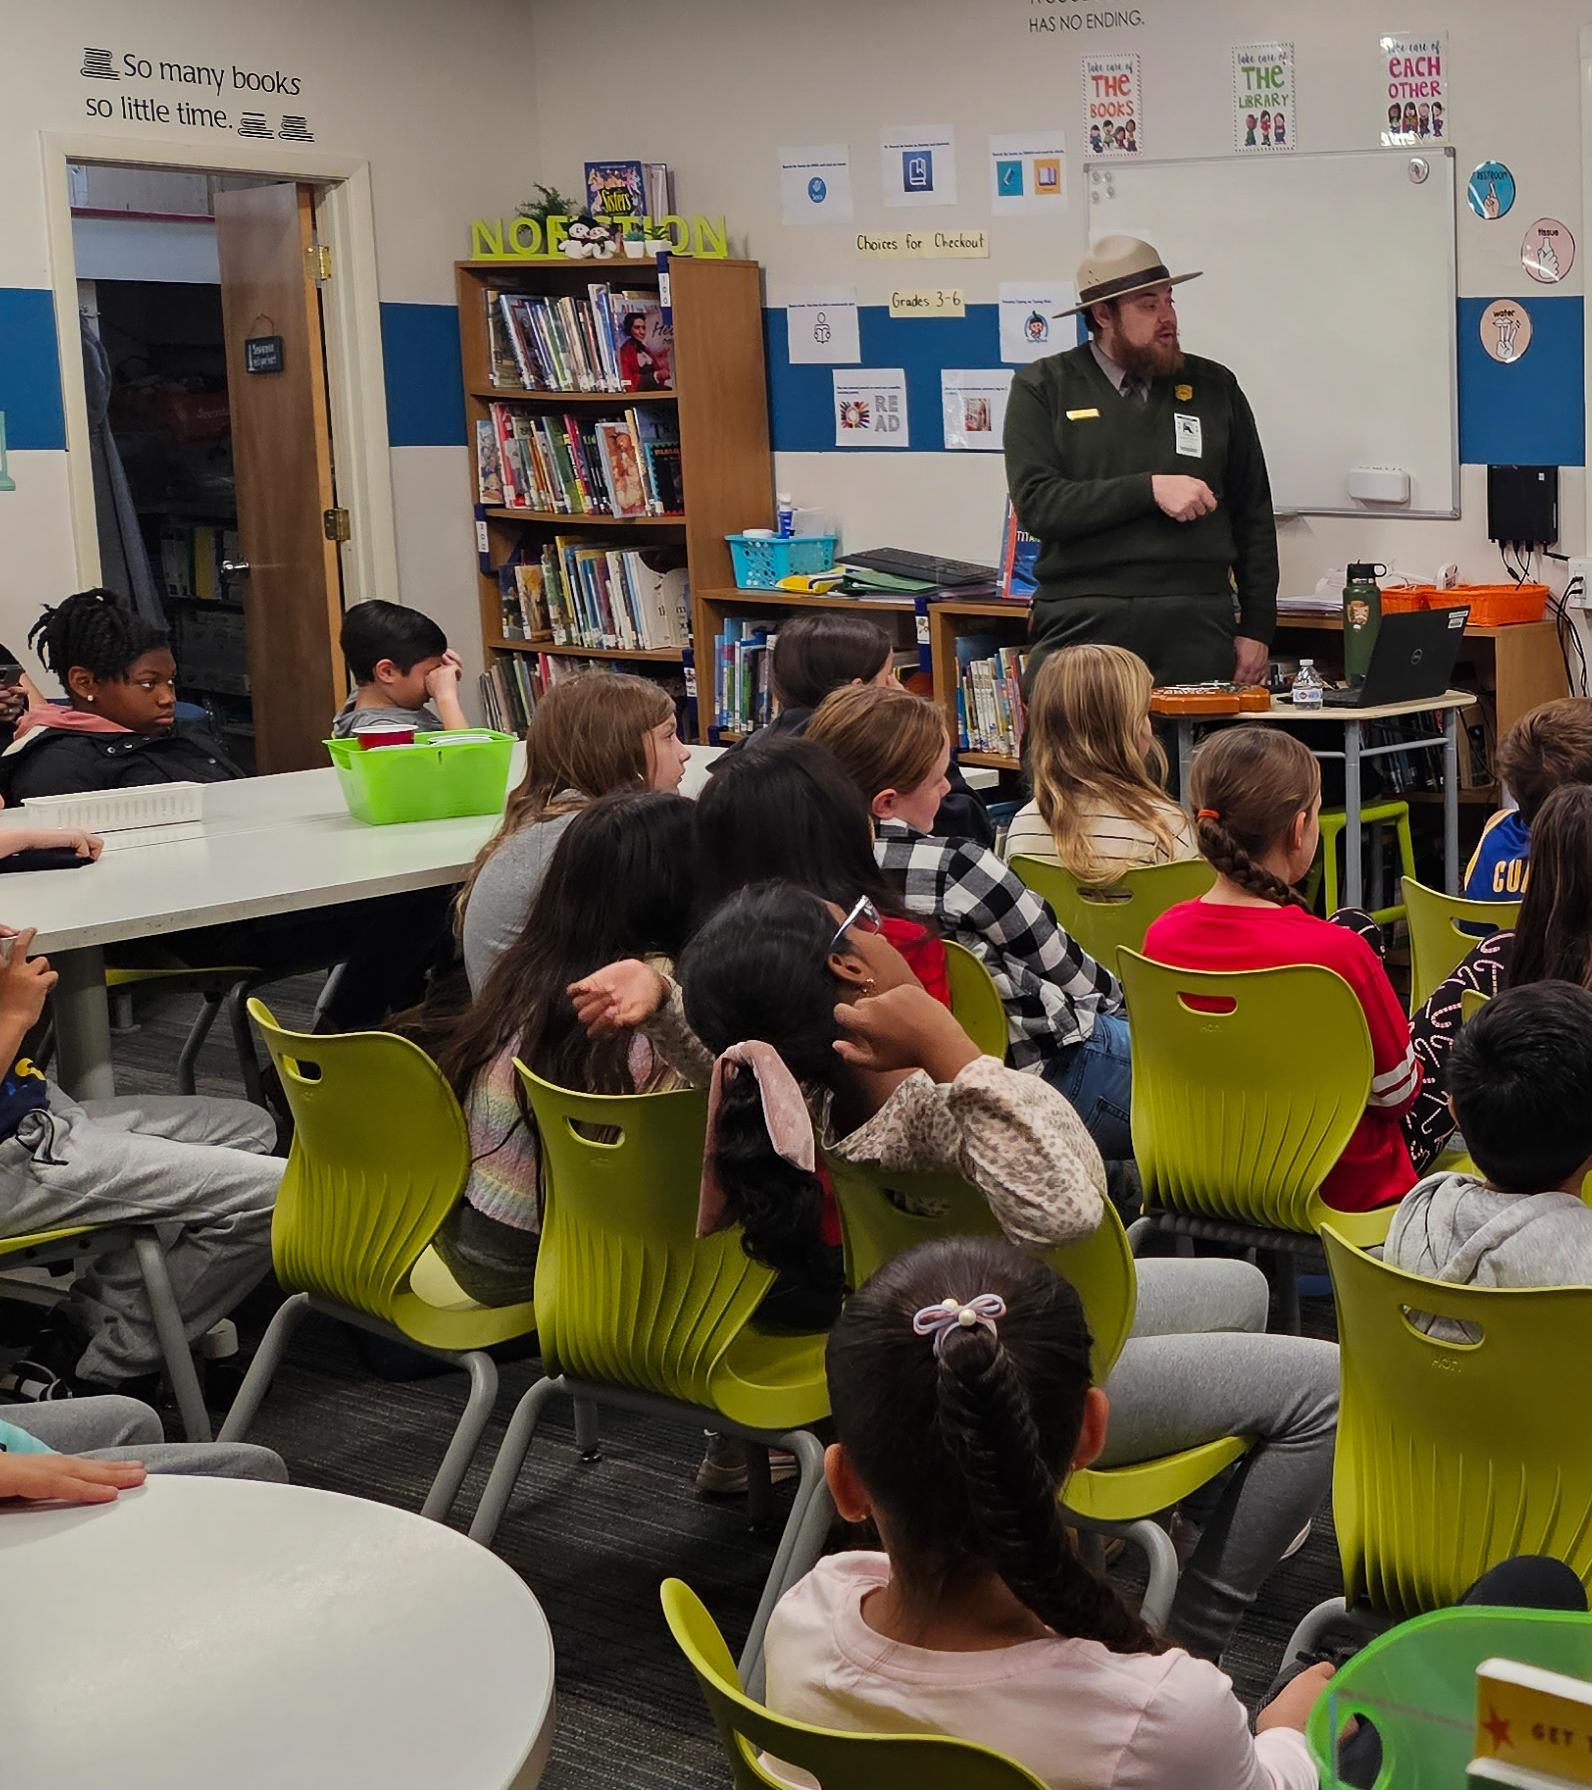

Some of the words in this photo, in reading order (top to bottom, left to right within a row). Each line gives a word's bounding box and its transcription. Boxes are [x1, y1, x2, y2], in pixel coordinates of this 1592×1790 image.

[1029, 16, 1056, 32] HAS
[1060, 14, 1082, 30] NO
[1086, 10, 1145, 29] ENDING.
[123, 54, 153, 80] So
[159, 61, 225, 96] many
[231, 65, 302, 96] books
[86, 98, 113, 118] so
[120, 96, 170, 123] little
[176, 102, 233, 129] time.
[1090, 100, 1134, 119] BOOKS
[856, 234, 898, 251] Choices
[905, 234, 923, 249] for
[934, 232, 985, 249] Checkout
[1538, 228, 1559, 237] tissue
[892, 291, 930, 308] Grades
[936, 291, 962, 307] 3-6
[1493, 309, 1516, 318] water
[874, 395, 899, 413] RE
[874, 414, 900, 433] AD
[1530, 1722, 1574, 1747] GET
